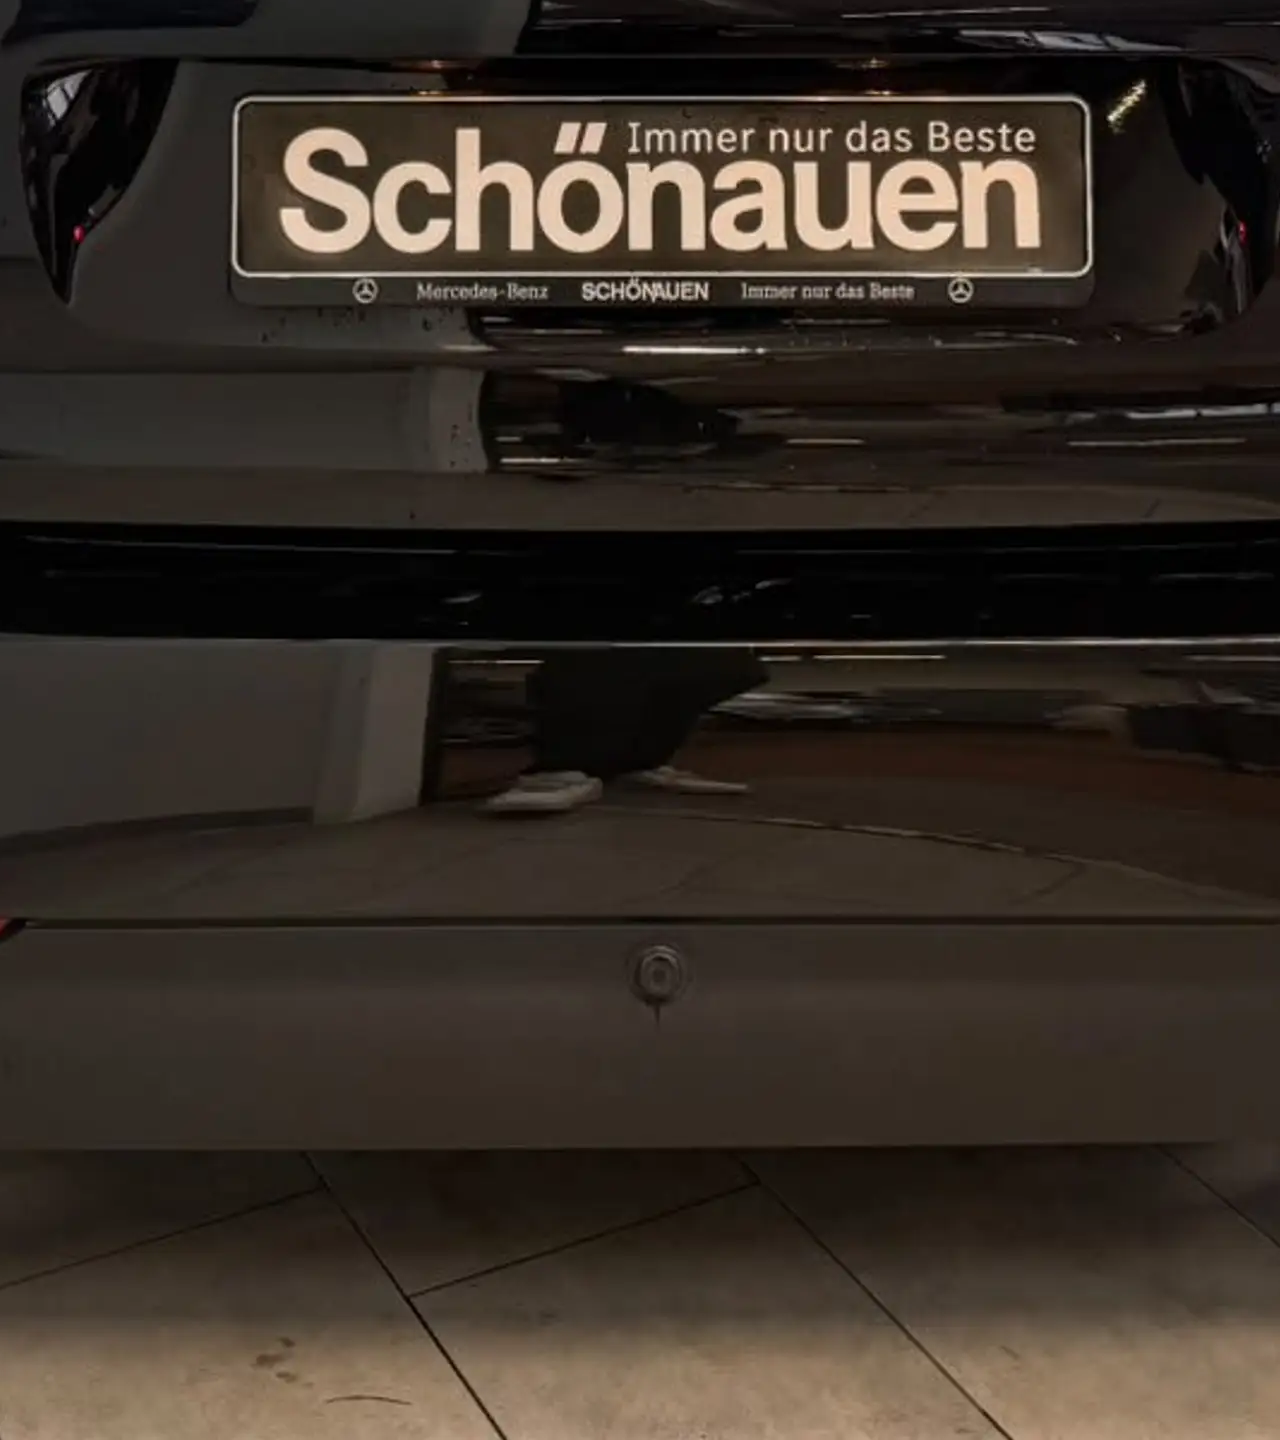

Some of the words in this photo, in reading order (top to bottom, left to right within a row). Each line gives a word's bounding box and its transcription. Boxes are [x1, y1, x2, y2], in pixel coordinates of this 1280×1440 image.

[628, 121, 755, 153] Immer
[769, 125, 833, 153] nur
[846, 121, 913, 153] das
[928, 121, 1037, 153] Beste
[280, 122, 1041, 253] Schönauen
[416, 282, 549, 301] Mercedes-Benz
[581, 275, 709, 302] SCHÖNAUEN
[741, 282, 797, 300] Immer
[802, 285, 832, 300] nur
[835, 282, 865, 300] das
[870, 282, 915, 300] Beste
